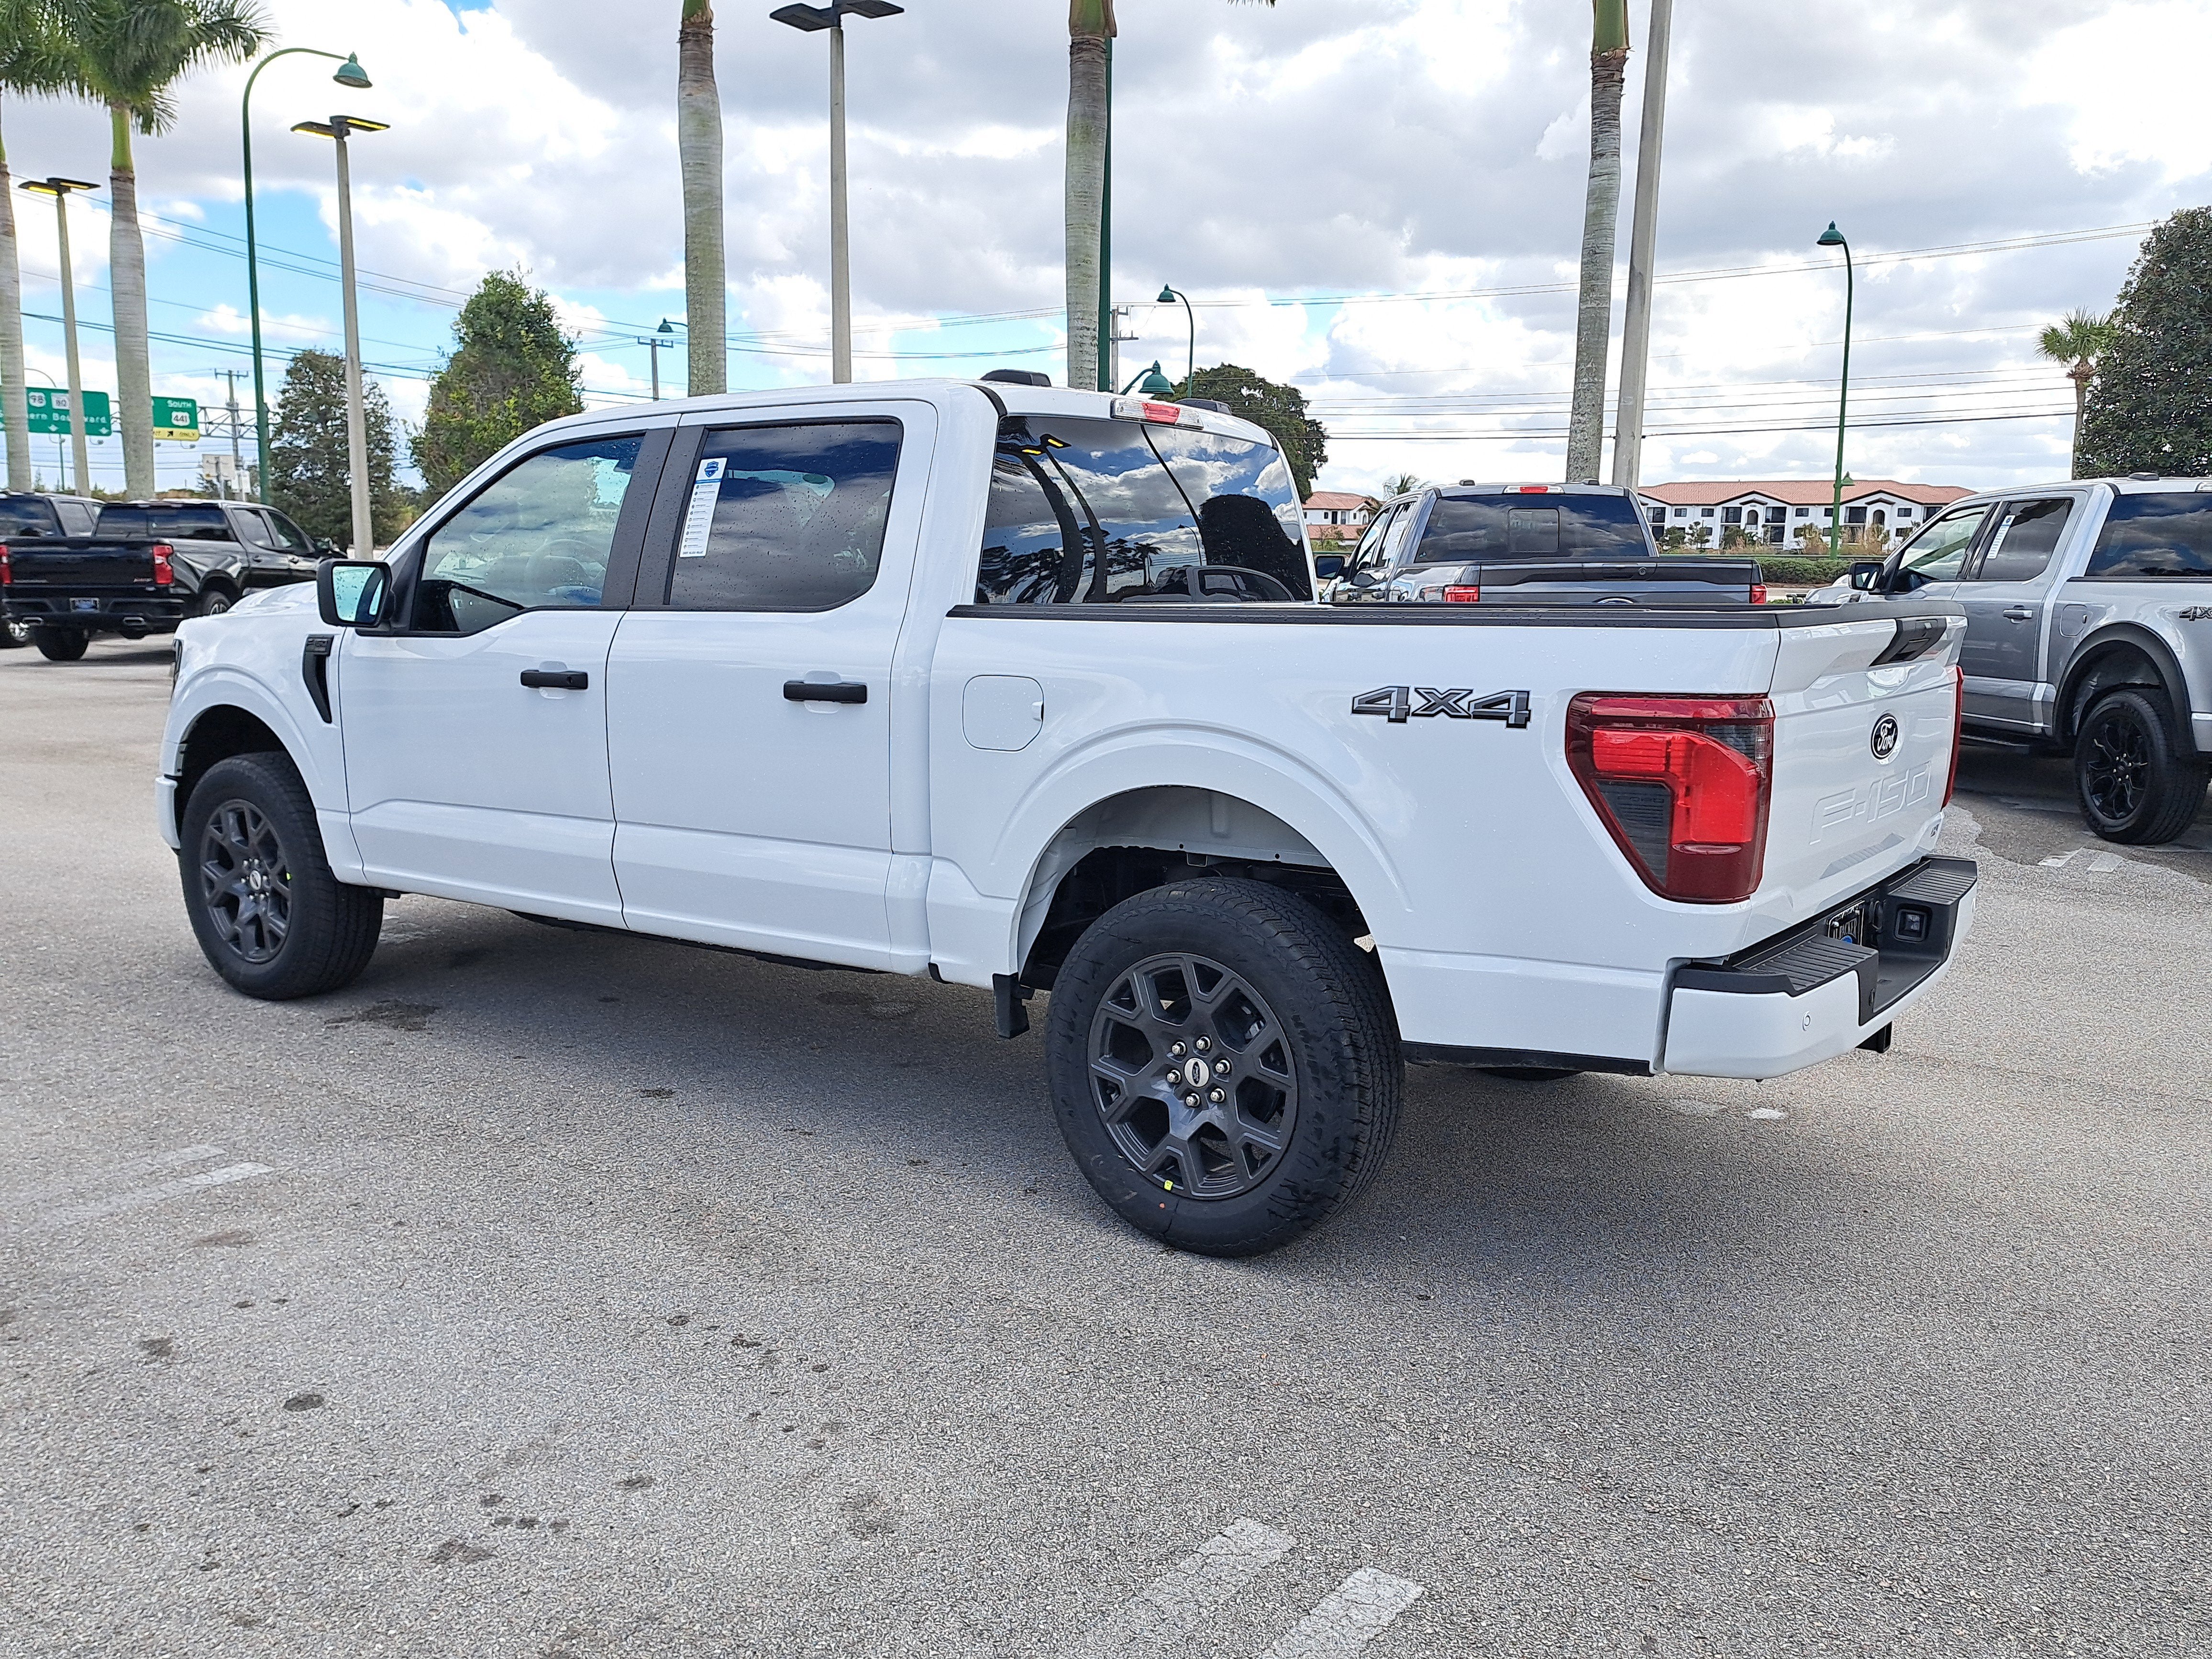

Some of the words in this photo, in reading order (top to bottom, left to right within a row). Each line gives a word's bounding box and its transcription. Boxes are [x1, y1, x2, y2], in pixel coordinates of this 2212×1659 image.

[173, 414, 188, 423] 441
[2179, 605, 2212, 622] 4X
[1877, 721, 1896, 752] Ford
[1809, 761, 1931, 845] F-150
